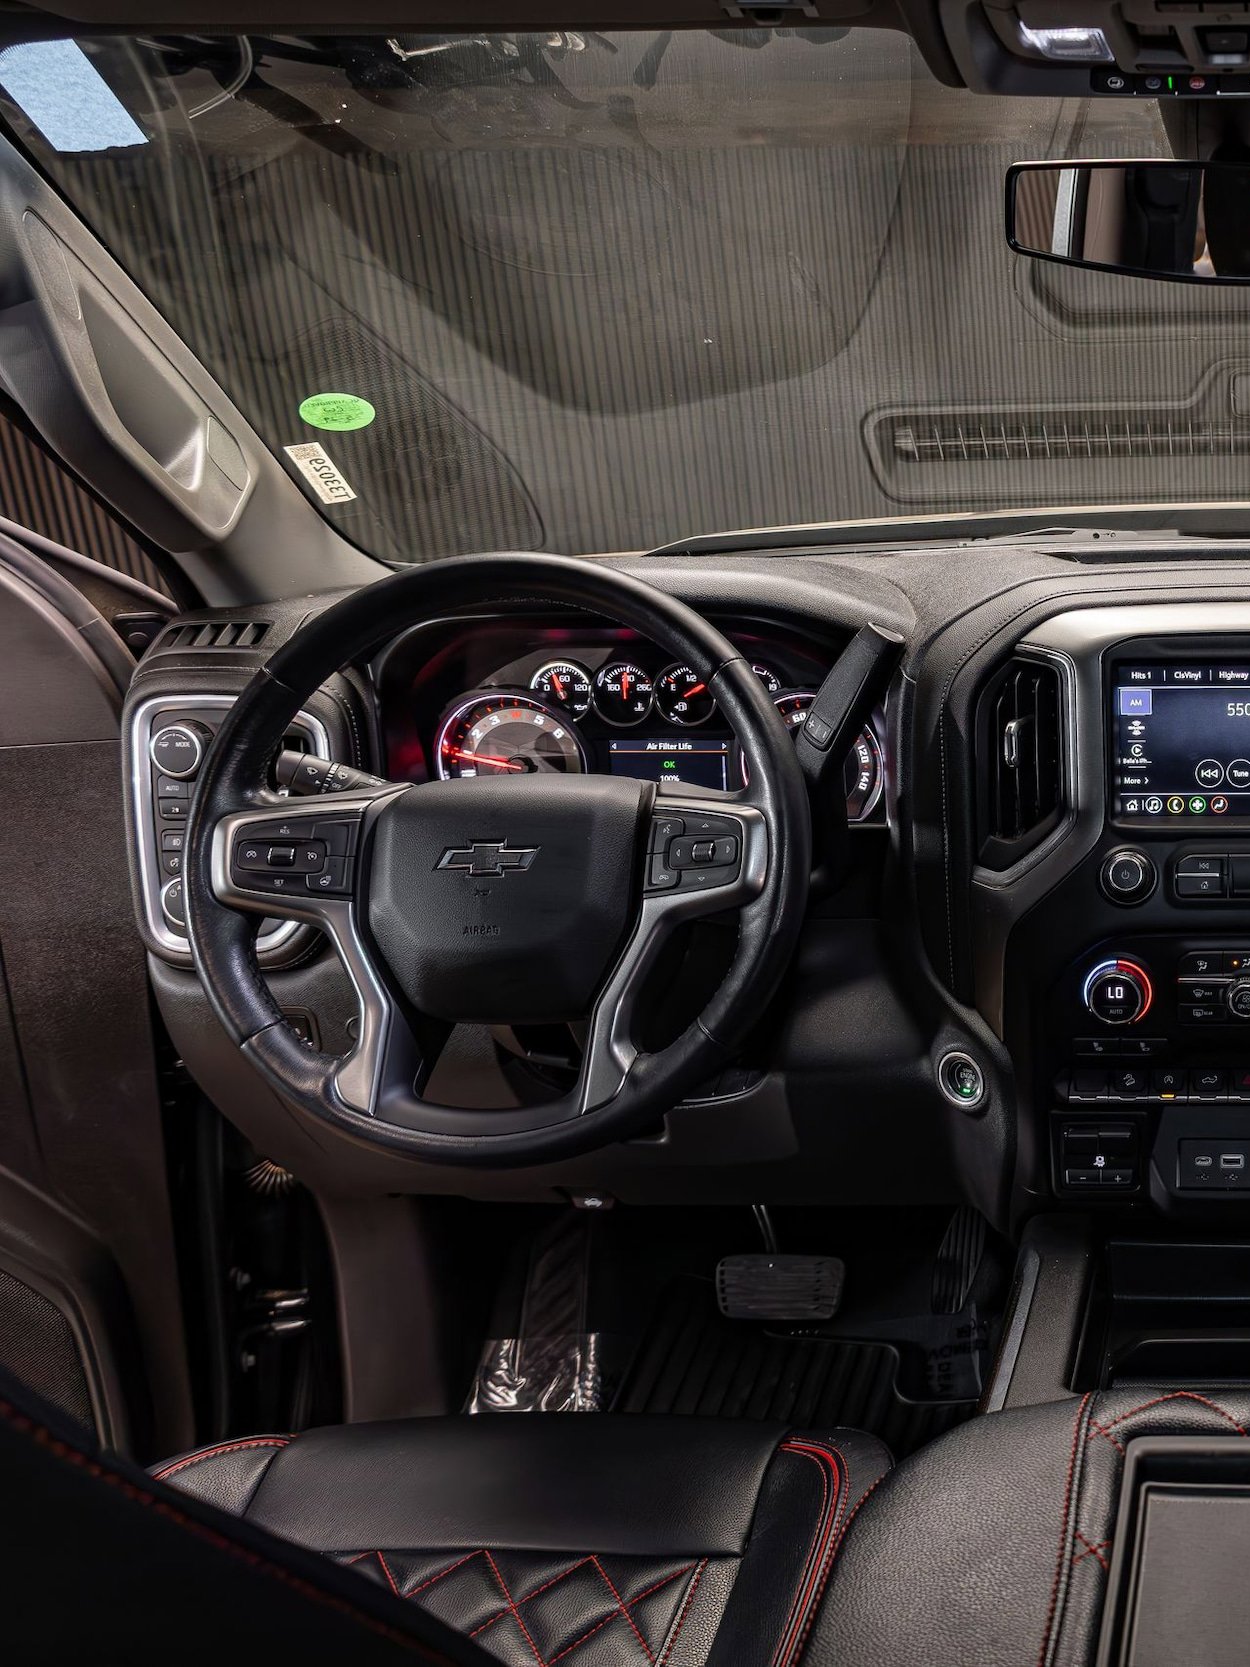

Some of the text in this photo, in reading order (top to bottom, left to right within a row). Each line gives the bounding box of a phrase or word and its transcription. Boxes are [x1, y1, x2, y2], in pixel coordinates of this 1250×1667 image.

[559, 675, 571, 683] 60
[1131, 671, 1146, 680] Hits
[1219, 671, 1249, 681] Highway
[543, 684, 551, 692] 0
[574, 684, 588, 692] 120
[606, 684, 621, 692] 160
[636, 684, 652, 692] 260
[670, 683, 677, 692] E
[1129, 699, 1143, 707] AM
[488, 715, 501, 726] 3
[533, 714, 545, 726] 5
[471, 728, 484, 740] 2
[552, 727, 565, 739] 6
[646, 742, 692, 751] Air Filter Life
[857, 745, 870, 764] 120
[663, 760, 676, 769] OK
[660, 774, 680, 782] 100%
[858, 771, 870, 791] 140
[1124, 776, 1141, 785] More
[1107, 986, 1124, 999] LO
